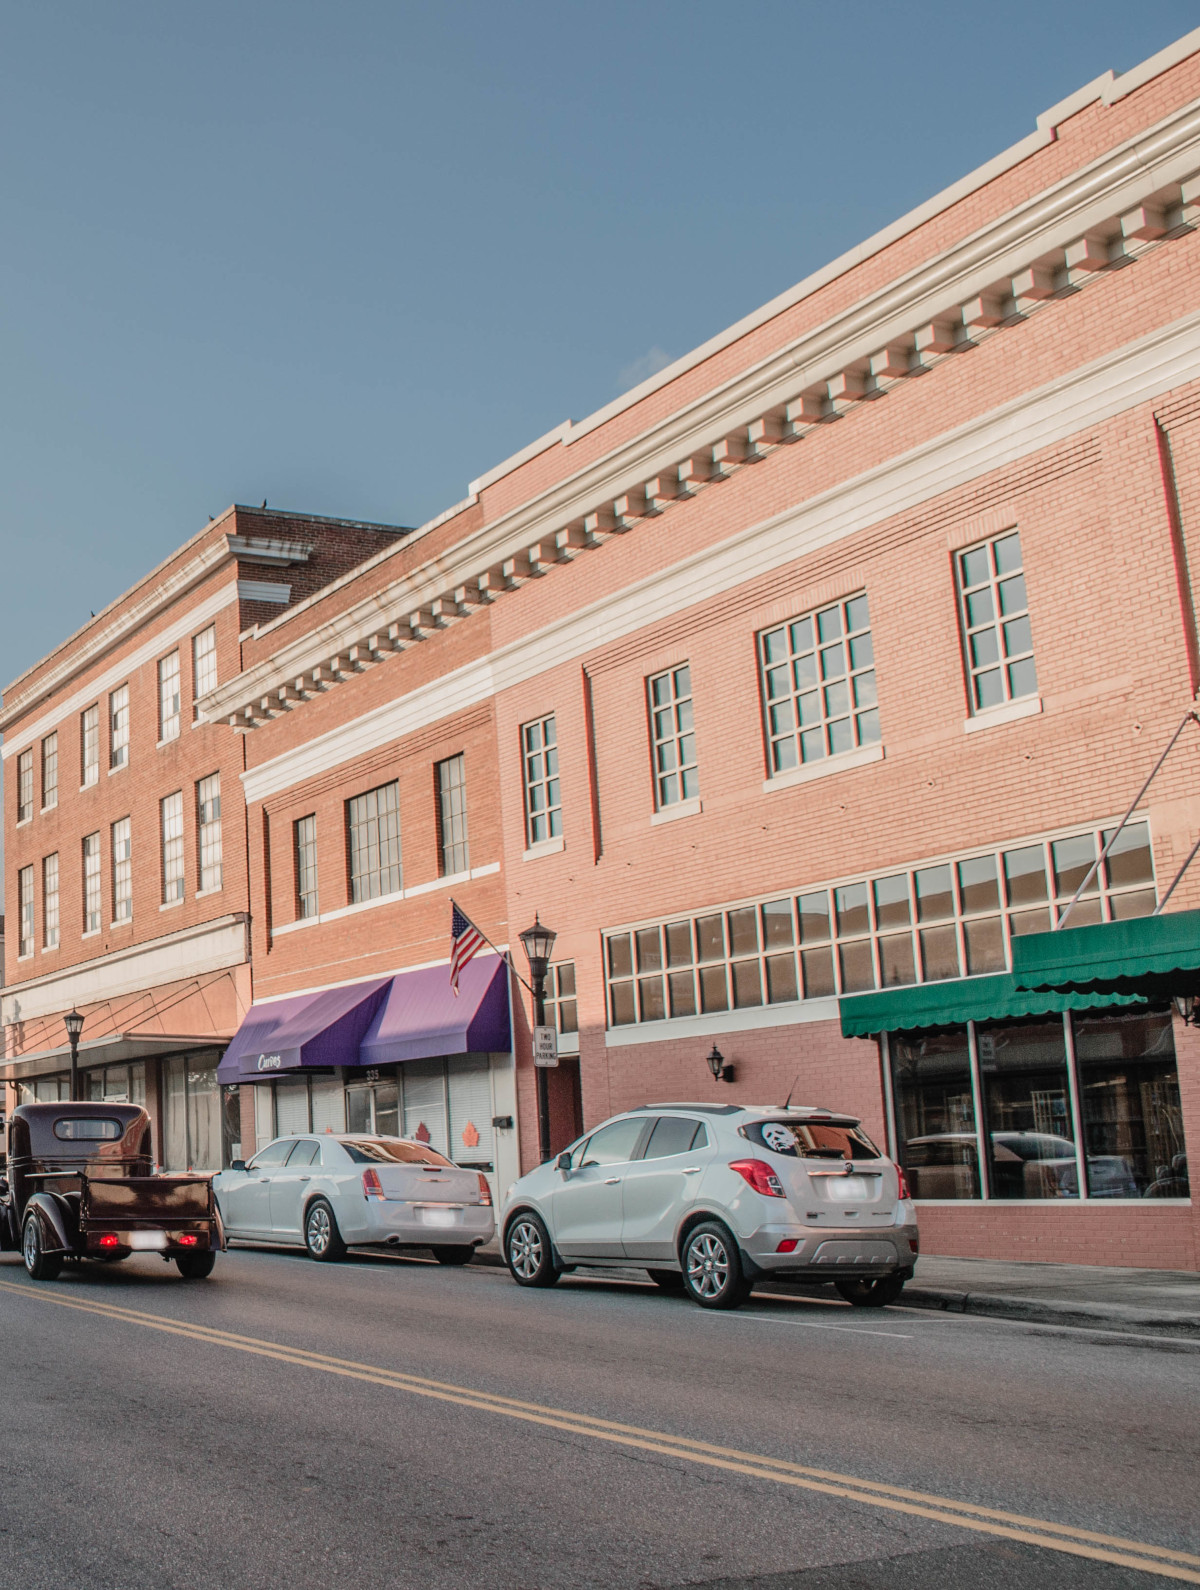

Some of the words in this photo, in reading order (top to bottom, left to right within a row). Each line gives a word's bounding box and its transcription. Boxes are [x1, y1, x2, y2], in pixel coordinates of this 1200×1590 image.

[540, 1032, 551, 1041] TWO
[539, 1042, 553, 1051] HOUR
[536, 1052, 556, 1060] PARKING
[258, 1054, 281, 1071] Curves
[366, 1069, 379, 1081] 335
